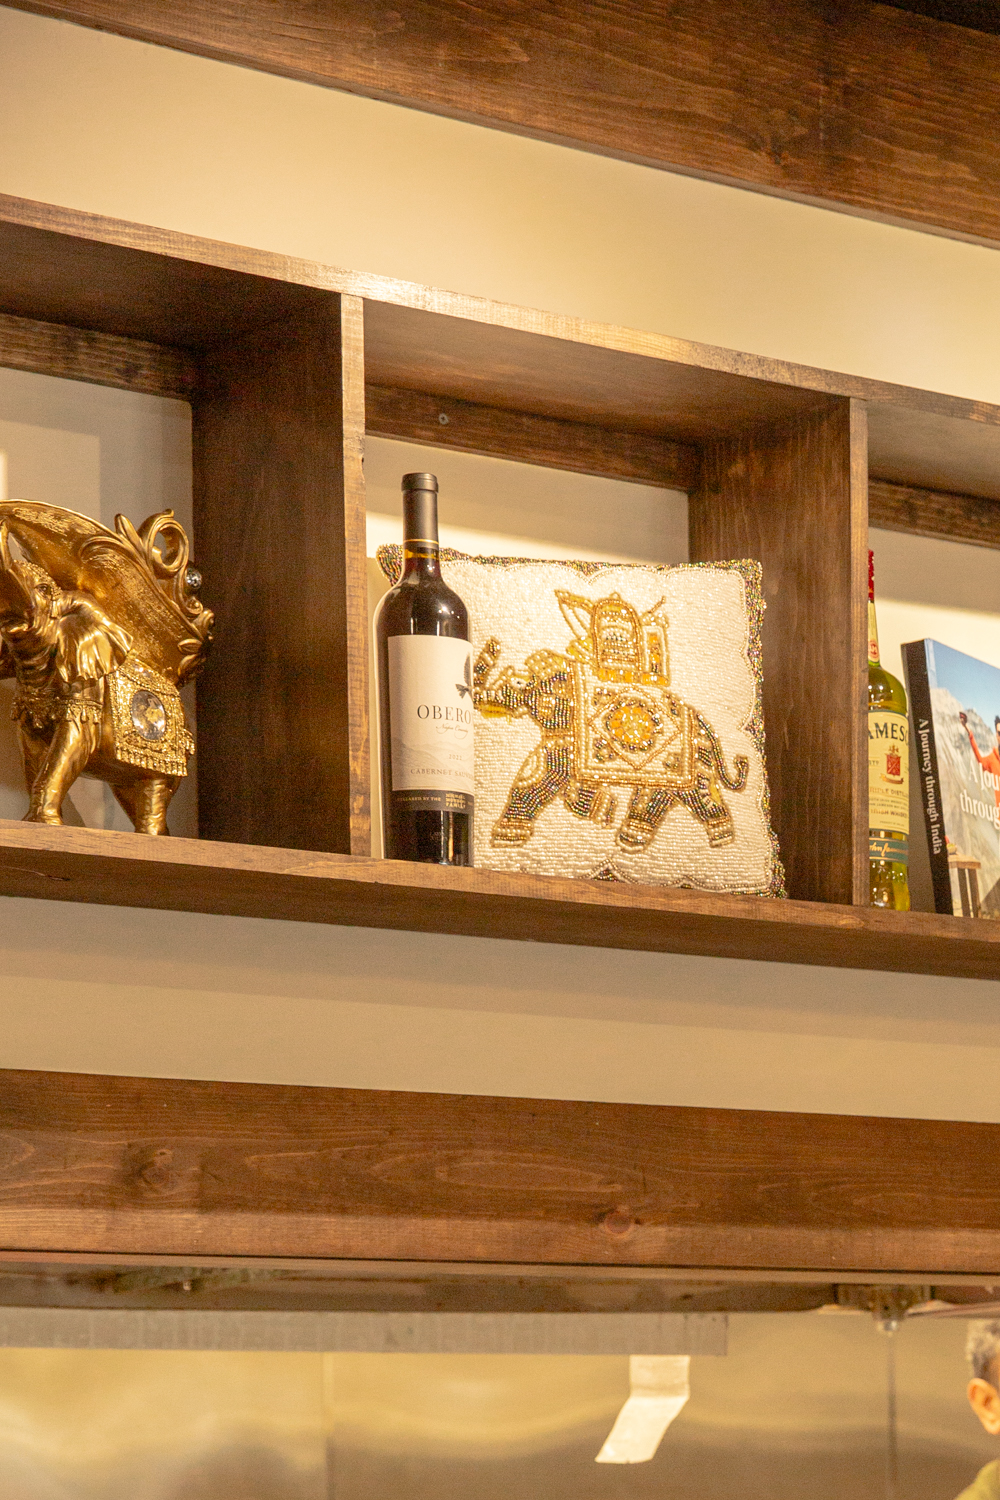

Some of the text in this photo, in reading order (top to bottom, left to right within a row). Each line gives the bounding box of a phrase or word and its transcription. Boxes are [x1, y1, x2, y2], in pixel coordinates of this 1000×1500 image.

[918, 718, 943, 856] A Journey through India
[969, 760, 978, 783] A
